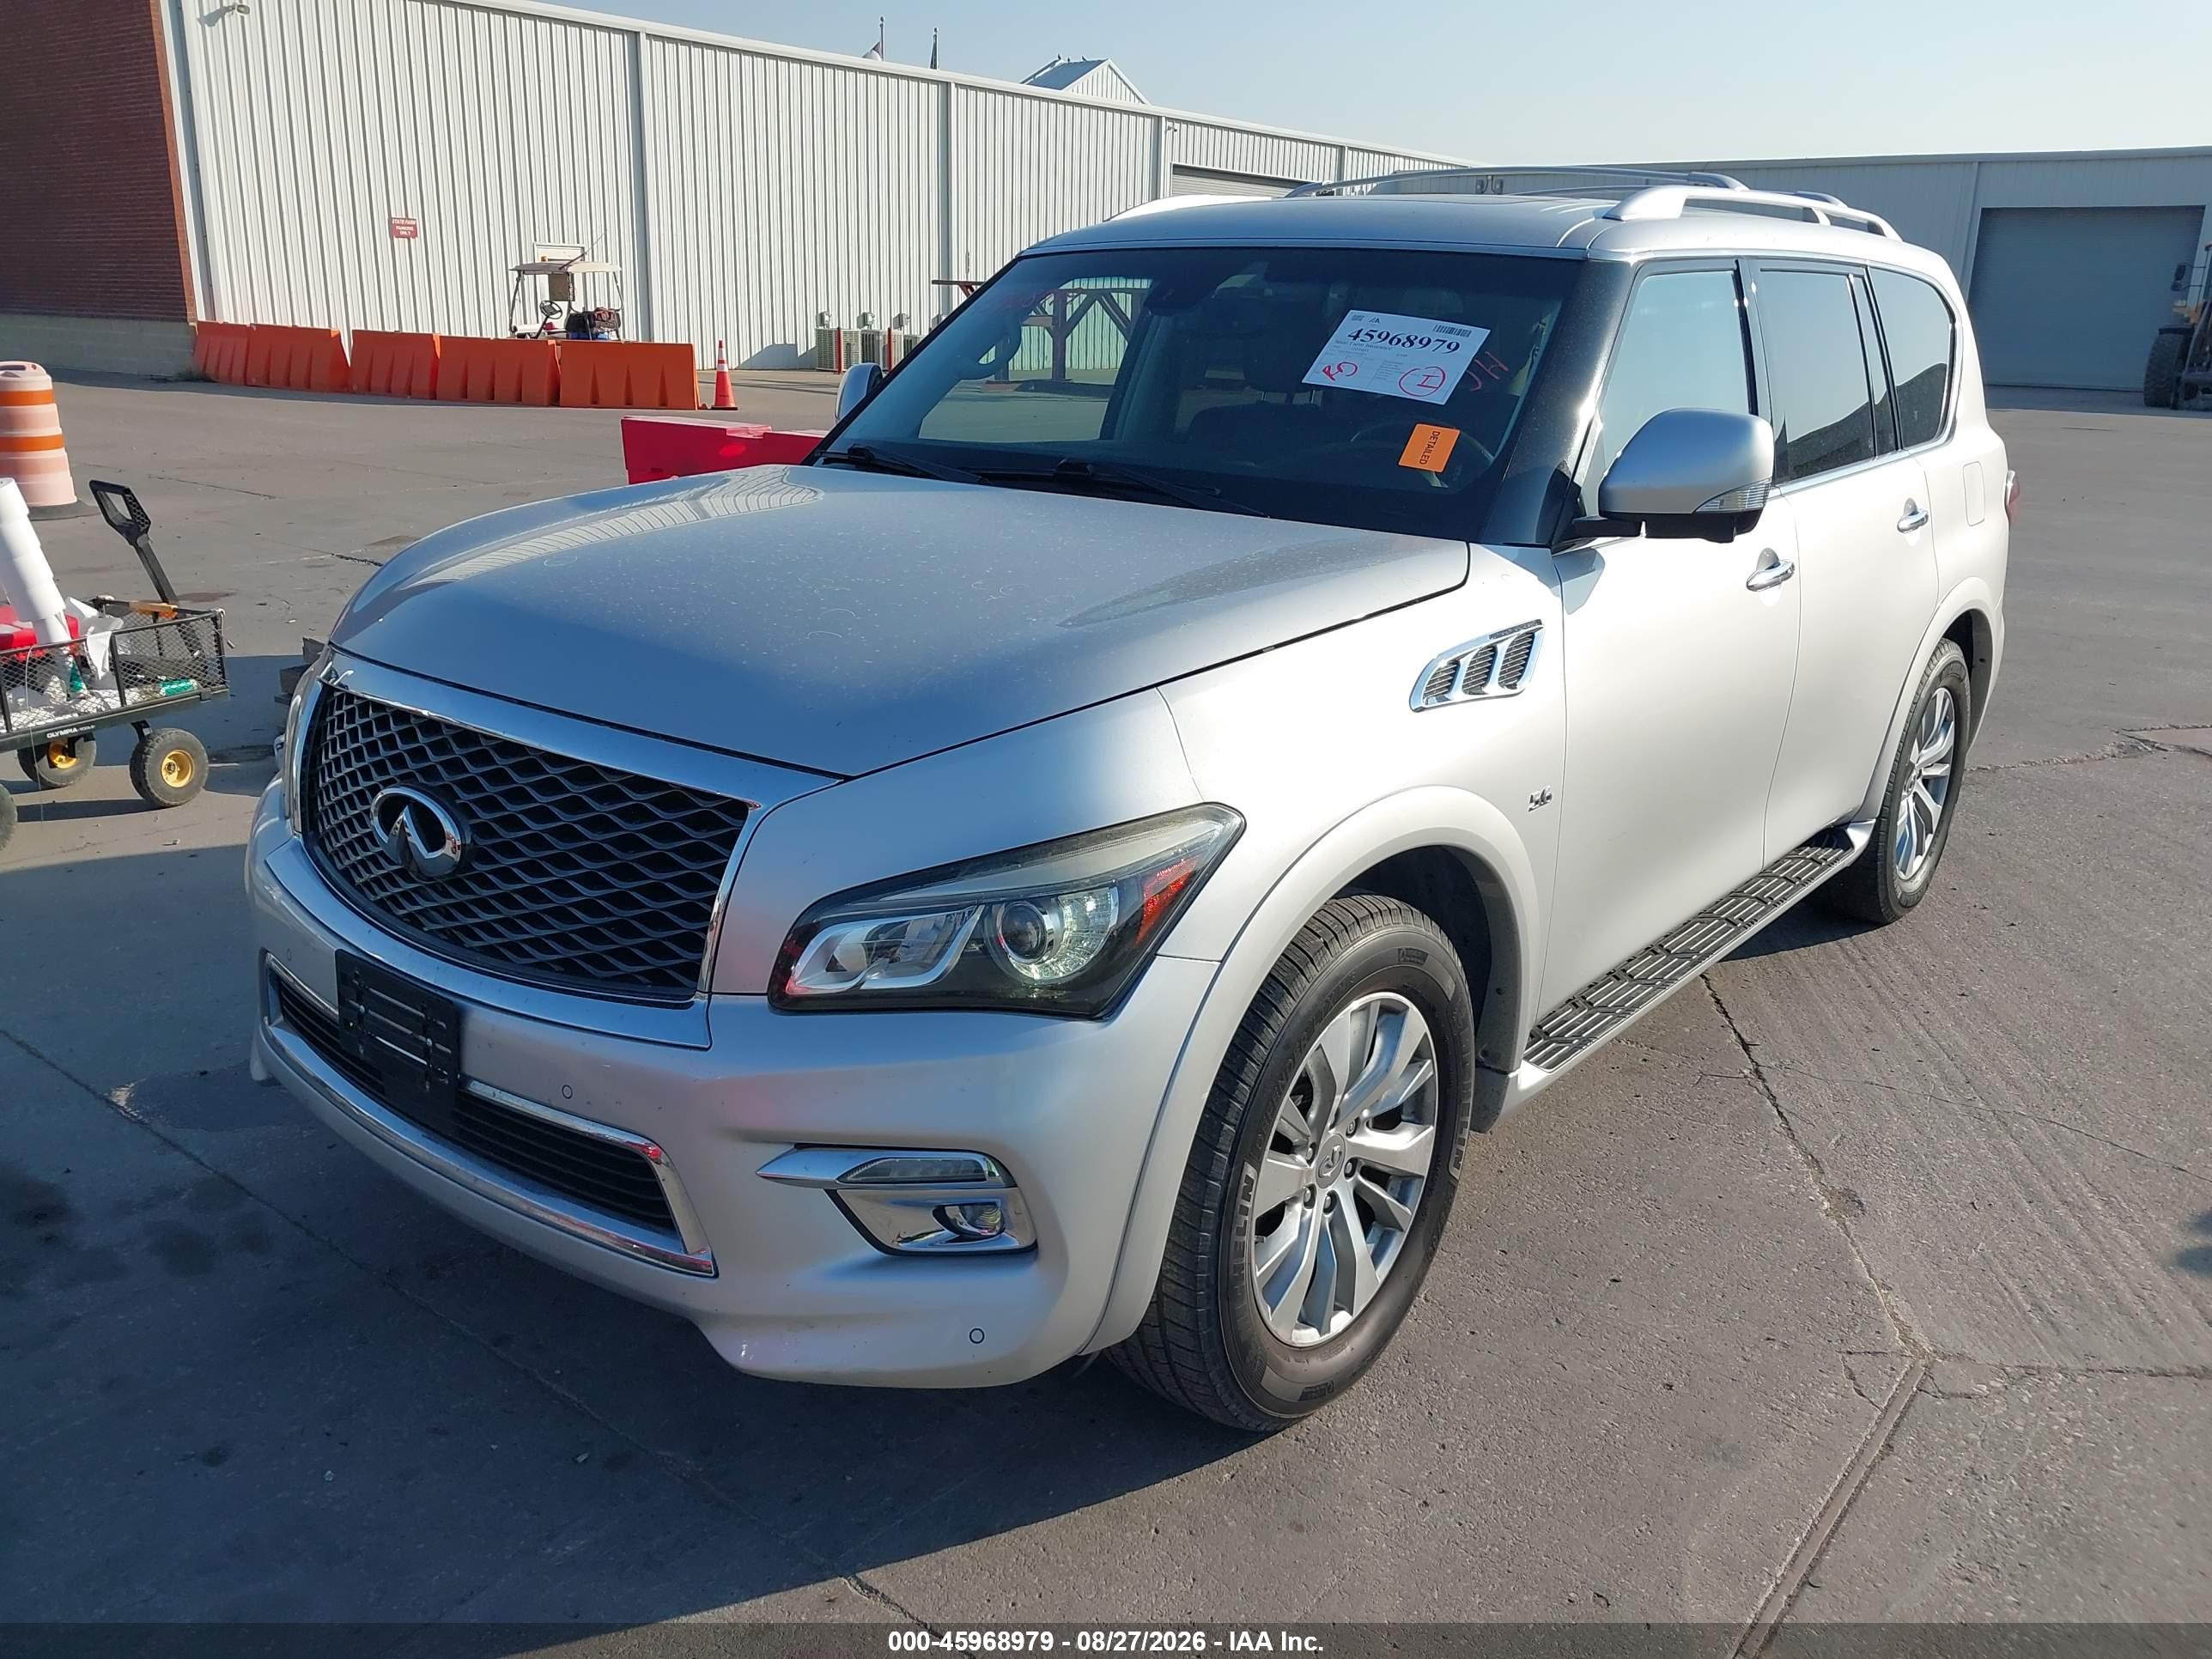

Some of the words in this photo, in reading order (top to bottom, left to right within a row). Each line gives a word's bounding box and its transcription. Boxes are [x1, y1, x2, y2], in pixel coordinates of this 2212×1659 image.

[1347, 327, 1461, 355] 45968979
[1419, 430, 1441, 465] DETAILED
[46, 728, 78, 738] OLYMPIA
